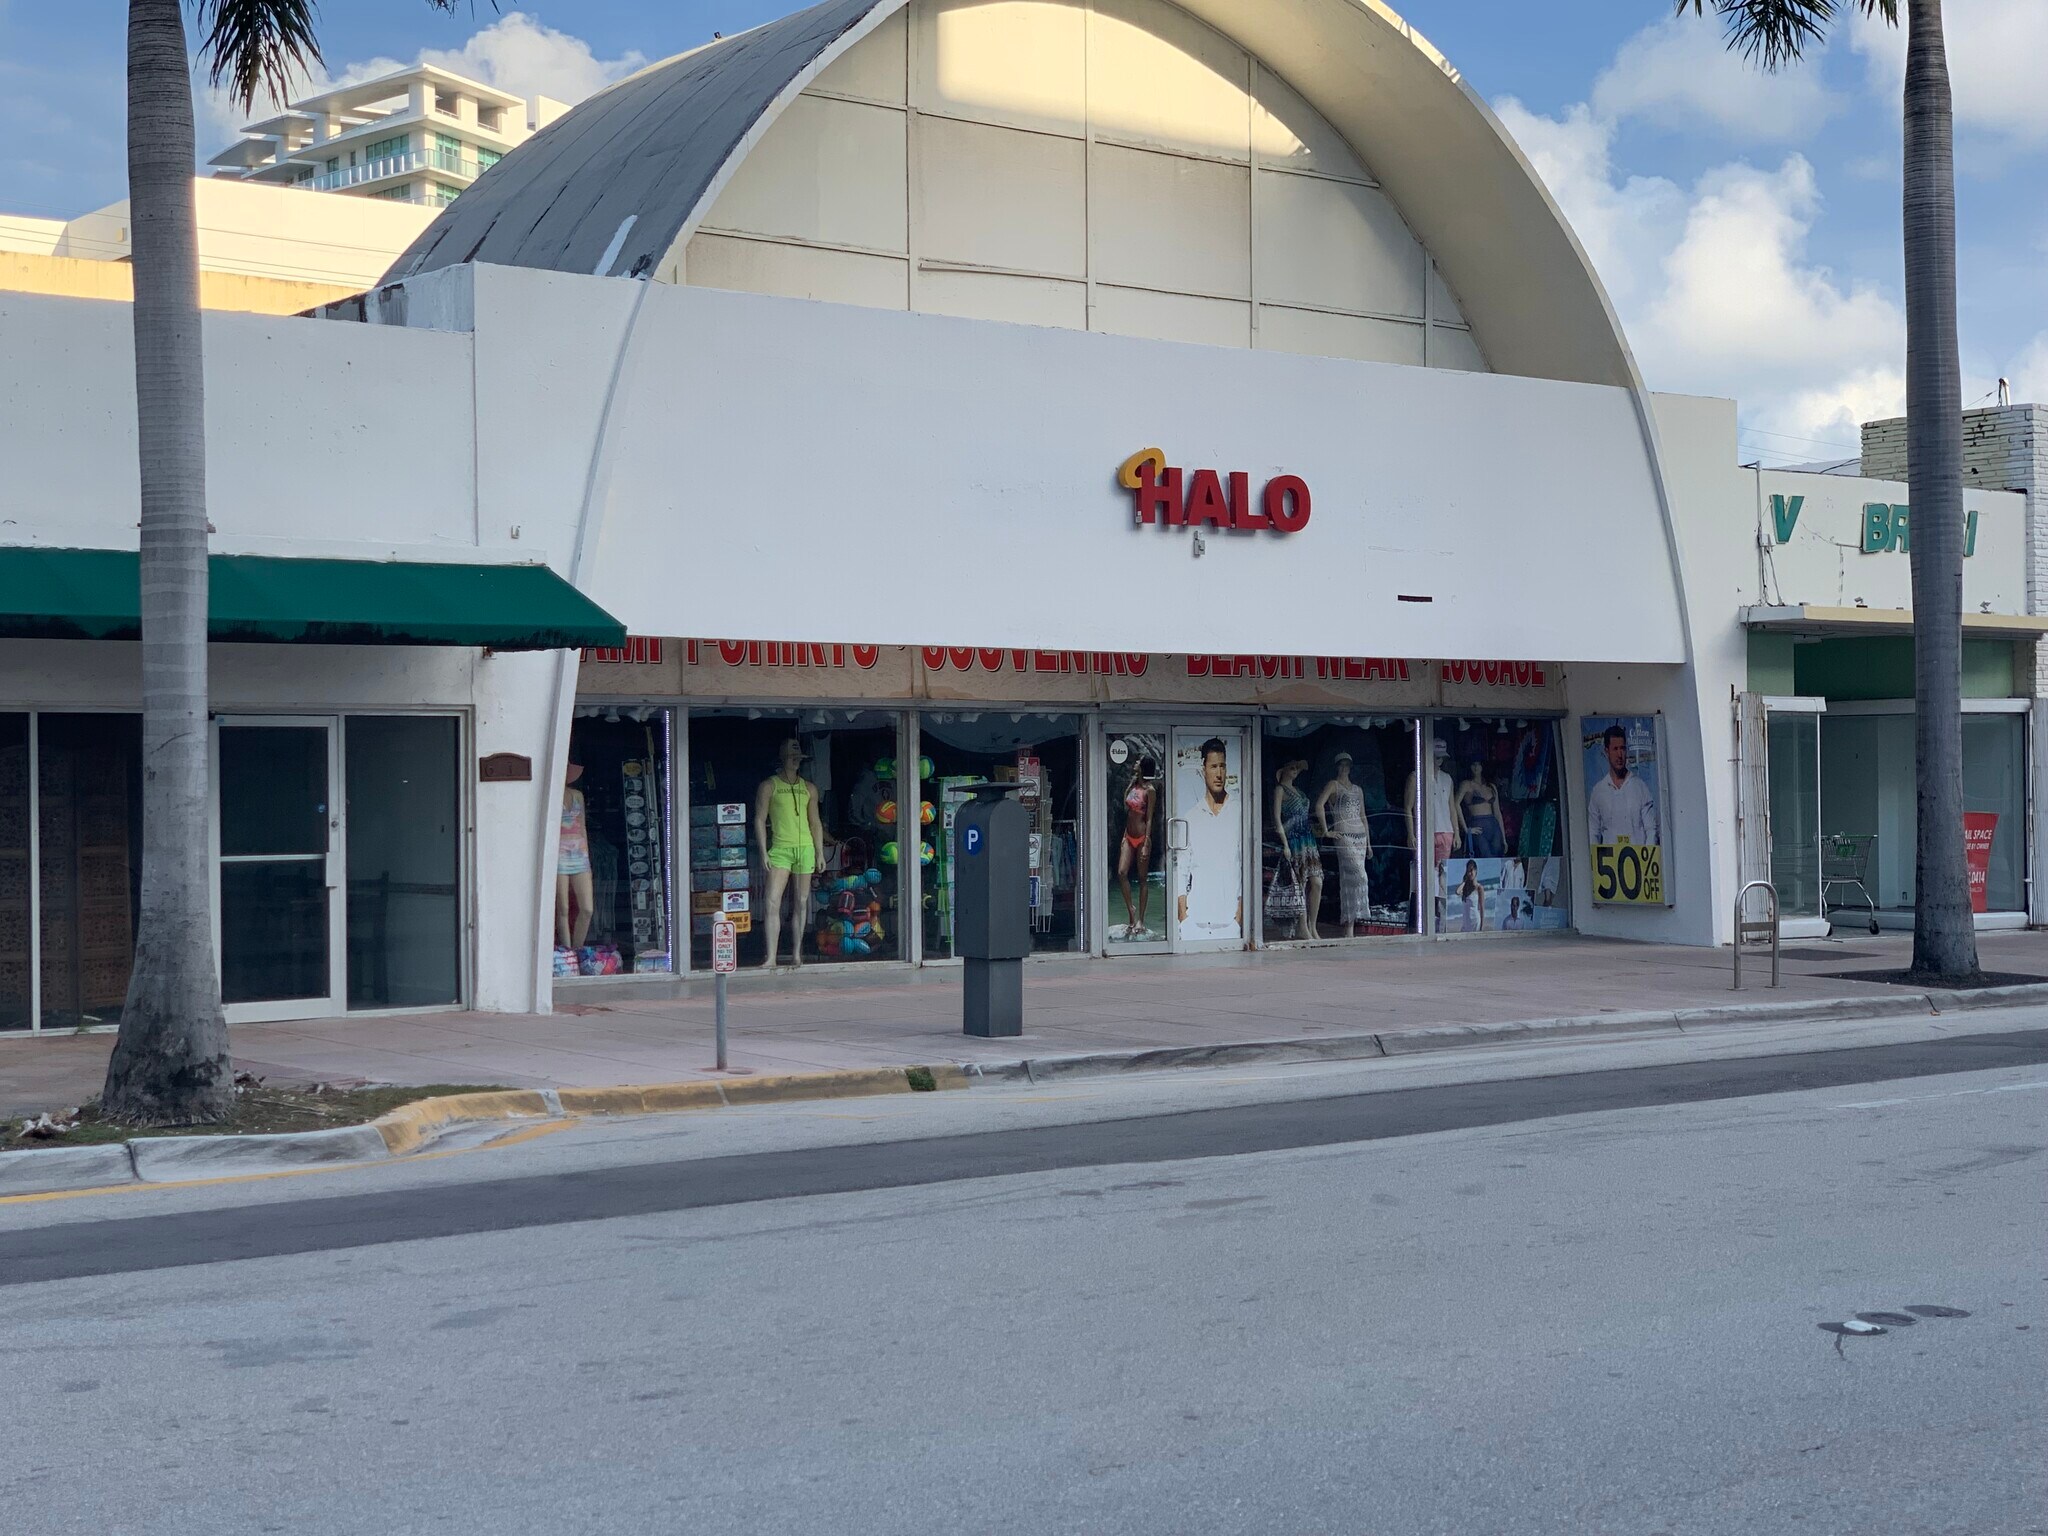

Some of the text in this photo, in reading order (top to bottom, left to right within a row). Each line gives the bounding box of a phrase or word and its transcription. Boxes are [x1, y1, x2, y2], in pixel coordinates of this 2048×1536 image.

[1135, 464, 1312, 533] HALO
[1769, 494, 1806, 545] V
[968, 829, 979, 850] P
[1974, 830, 1992, 839] SPACE
[1643, 877, 1660, 901] OFF
